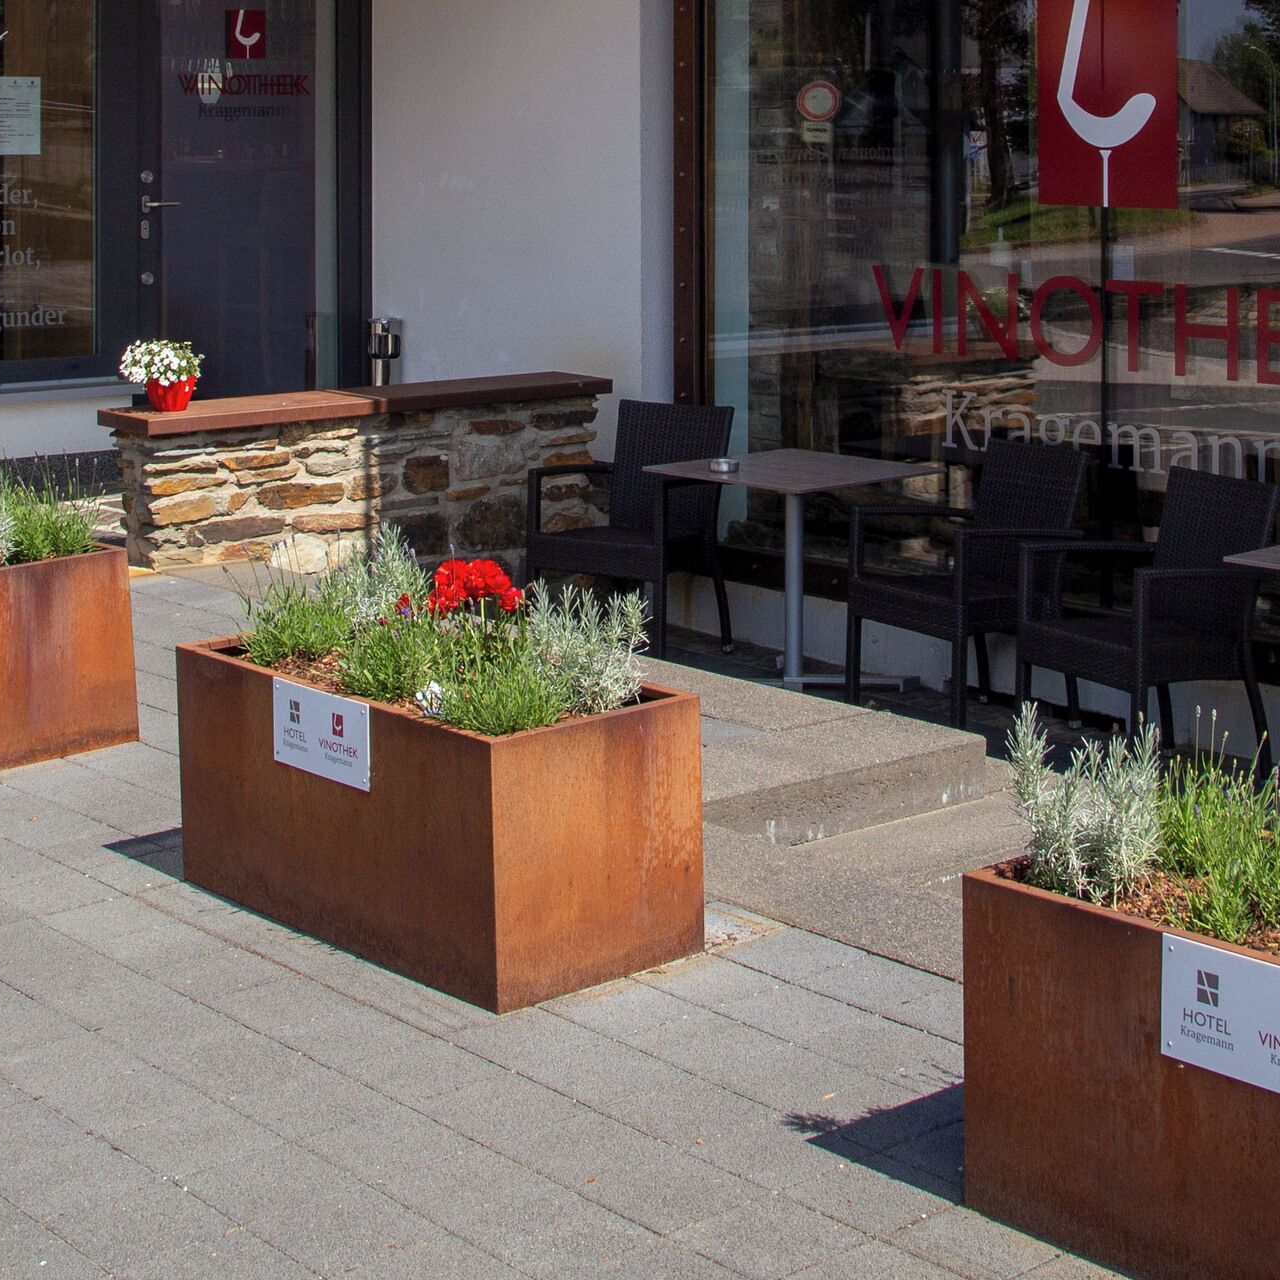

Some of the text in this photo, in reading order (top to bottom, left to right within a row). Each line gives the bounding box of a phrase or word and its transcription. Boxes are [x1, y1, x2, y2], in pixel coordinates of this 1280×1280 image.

[178, 74, 311, 96] VINOTHEK
[197, 103, 290, 121] Kragemann
[283, 725, 308, 743] HOTEL
[318, 737, 358, 759] VINOTHEK
[1183, 1007, 1232, 1036] HOTEL
[1180, 1024, 1234, 1052] Kragemann
